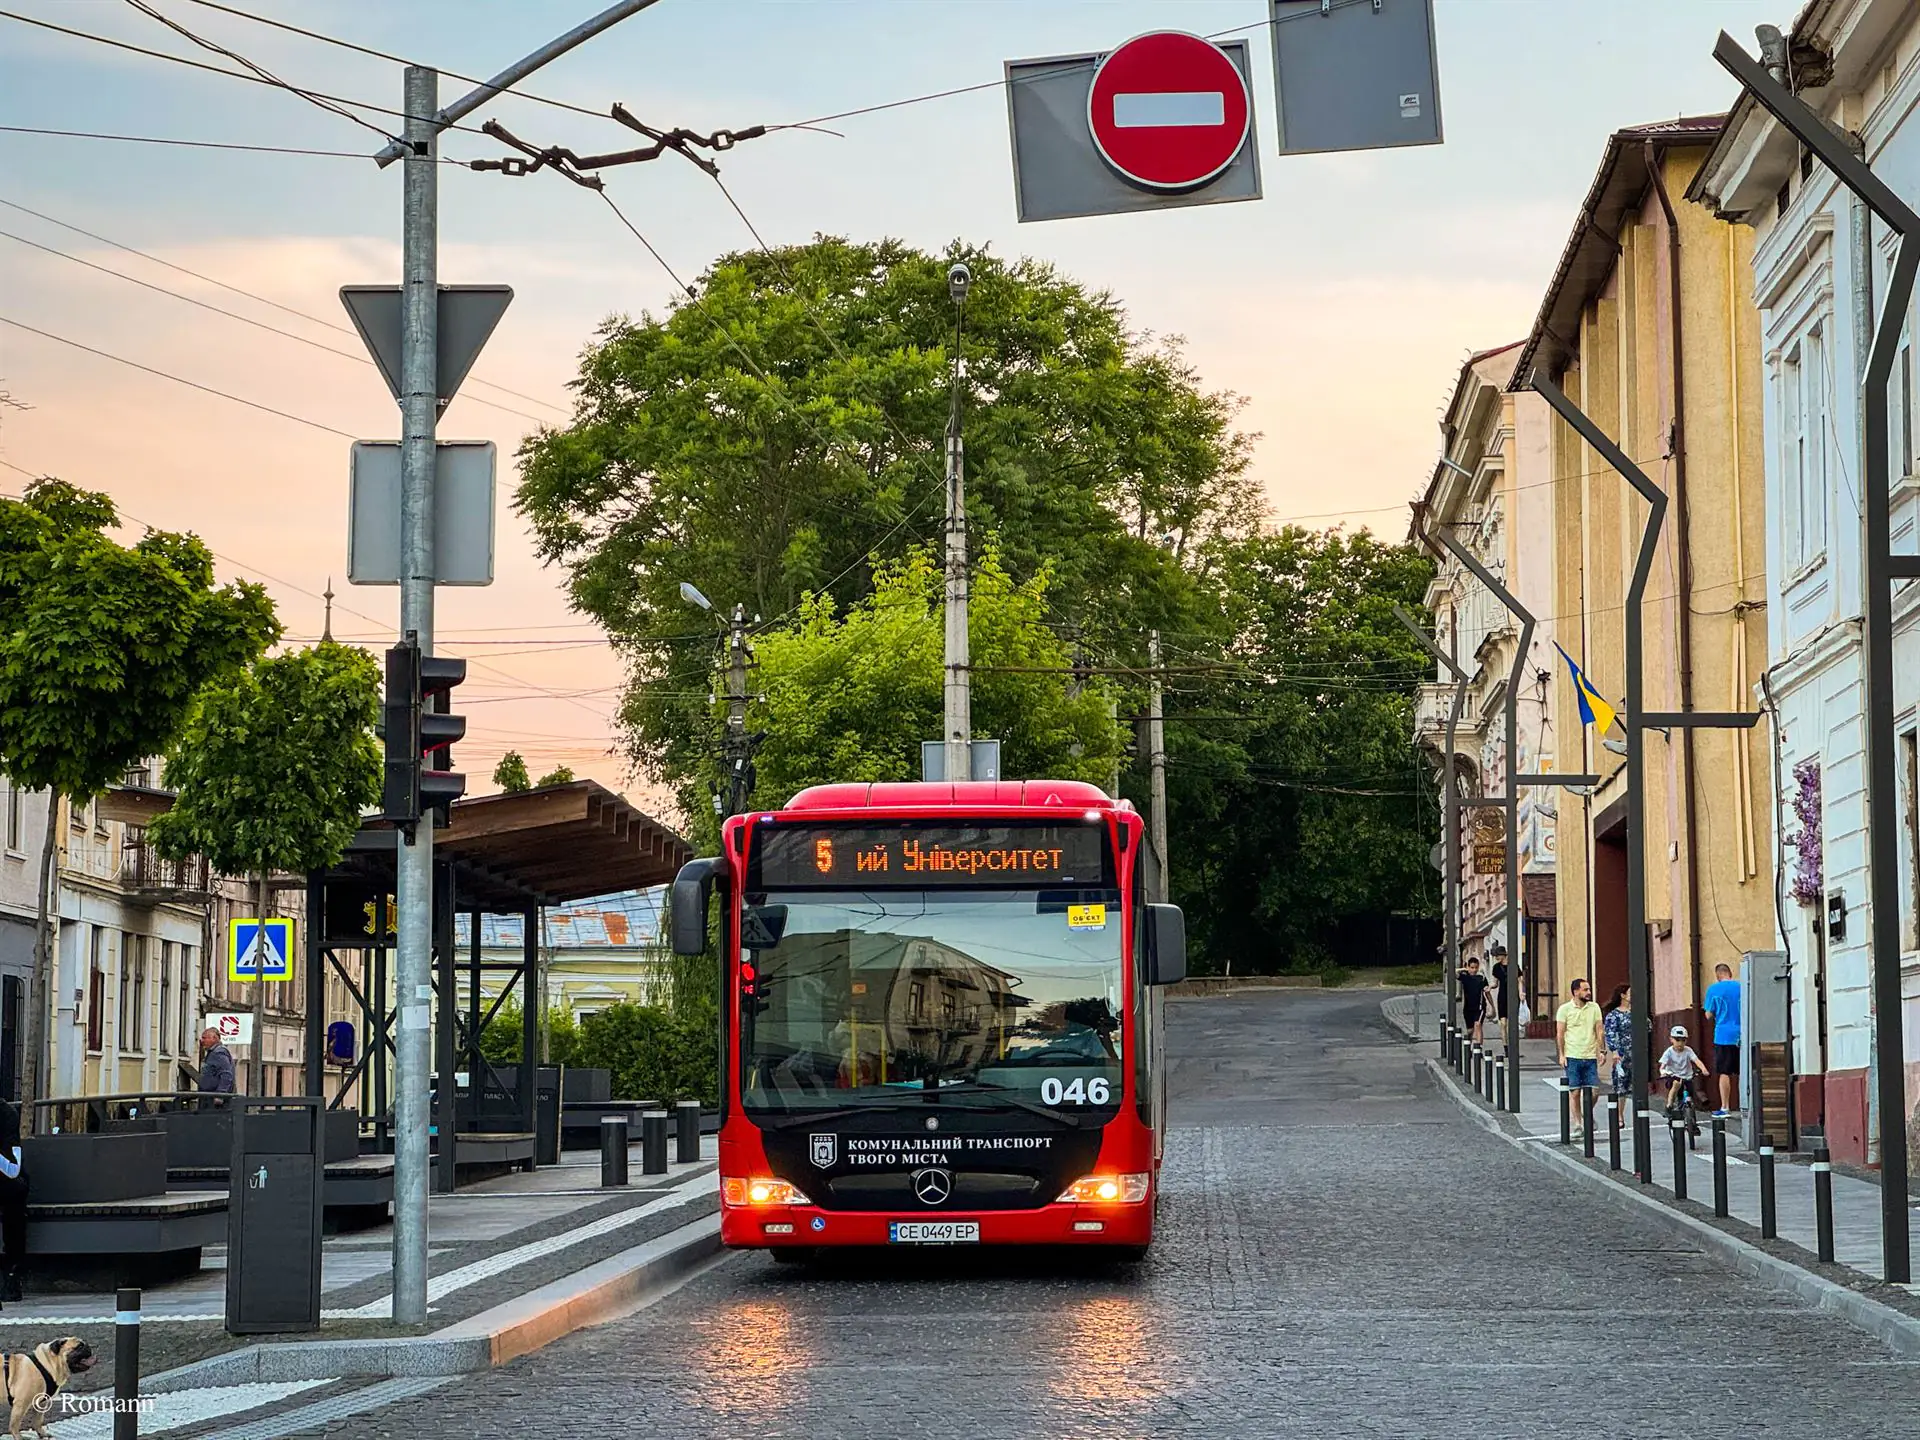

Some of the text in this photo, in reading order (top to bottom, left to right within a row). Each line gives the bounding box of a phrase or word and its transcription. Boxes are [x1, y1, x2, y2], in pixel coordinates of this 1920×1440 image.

[816, 838, 1063, 875] 5 ий Університет
[1041, 1077, 1110, 1106] 046
[848, 1137, 1053, 1151] КОМУНАЛЬНИЙ ТРАНСПОРТ
[848, 1153, 949, 1165] ТВОГО МІСТА
[921, 1225, 953, 1239] 0449
